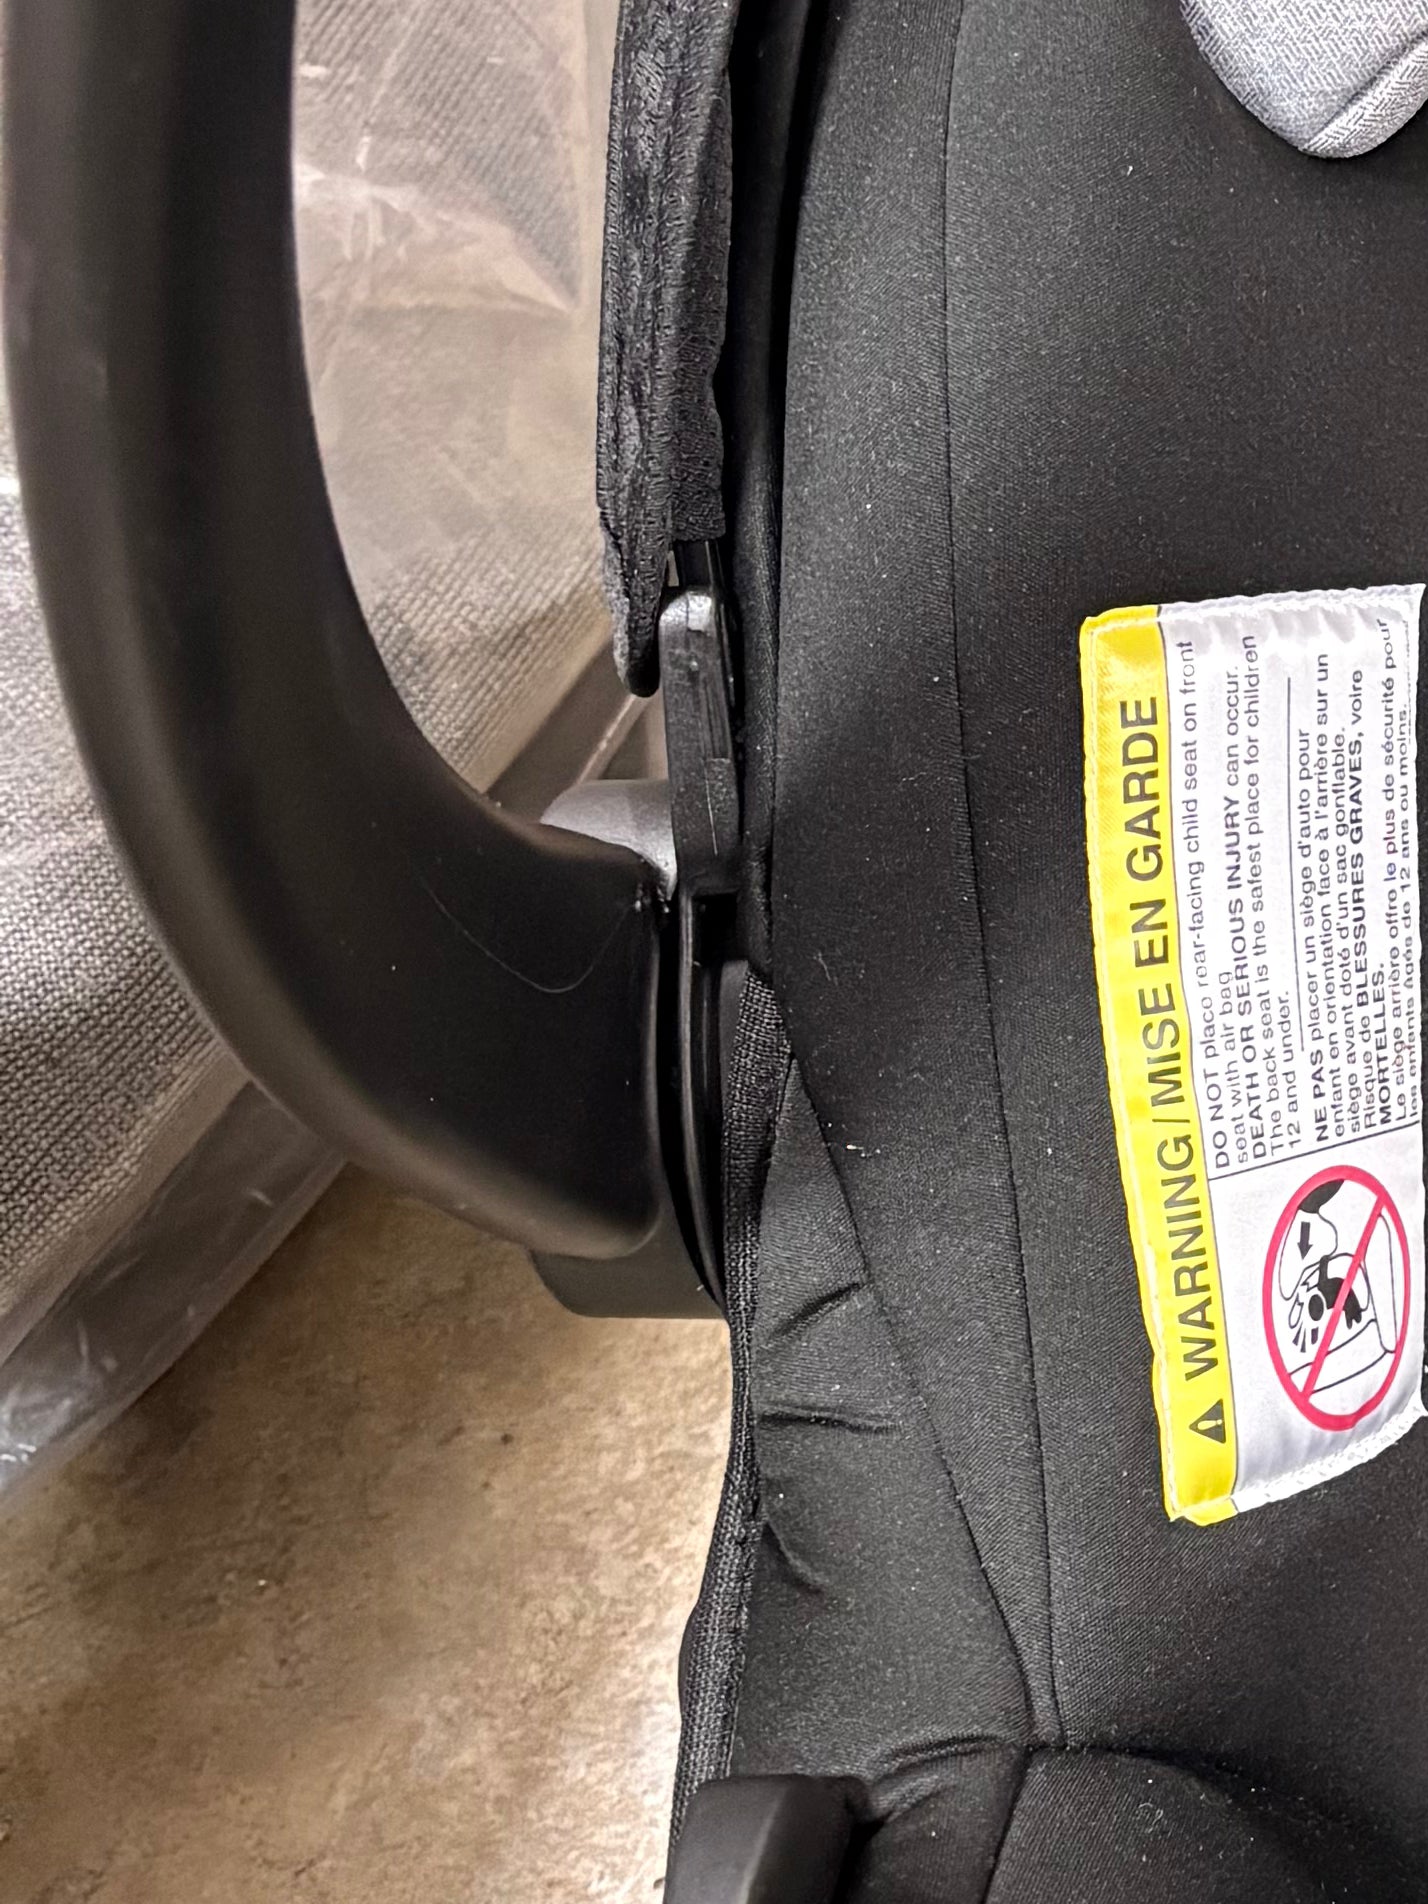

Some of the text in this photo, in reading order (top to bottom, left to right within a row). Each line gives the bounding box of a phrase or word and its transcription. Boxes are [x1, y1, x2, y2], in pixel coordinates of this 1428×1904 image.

[1120, 697, 1163, 881] GARDE
[1130, 898, 1169, 968] EN
[1176, 642, 1230, 1168] DO NOT place rear-facing child seat on front
[1224, 667, 1266, 1159] DEATH OR SERIOUS INJURY can occur.
[1242, 636, 1284, 1156] The back seat is the safest place for children
[1297, 729, 1329, 1142] NE PAS placer un siège d'auto pour
[1314, 654, 1344, 1137] enfant en orientation face à l'arrière sur un
[1332, 728, 1362, 1133] siège avant doté d'un sac gonflable.
[1348, 670, 1377, 1129] Risque de BLESSURES GRAVES, voire
[1376, 619, 1406, 1121] Le siège arrière offre le plus de sécurité pour
[1219, 972, 1248, 1163] seat with air bag
[1278, 992, 1301, 1148] 12 and under.
[1372, 963, 1391, 1125] MORTELLES.
